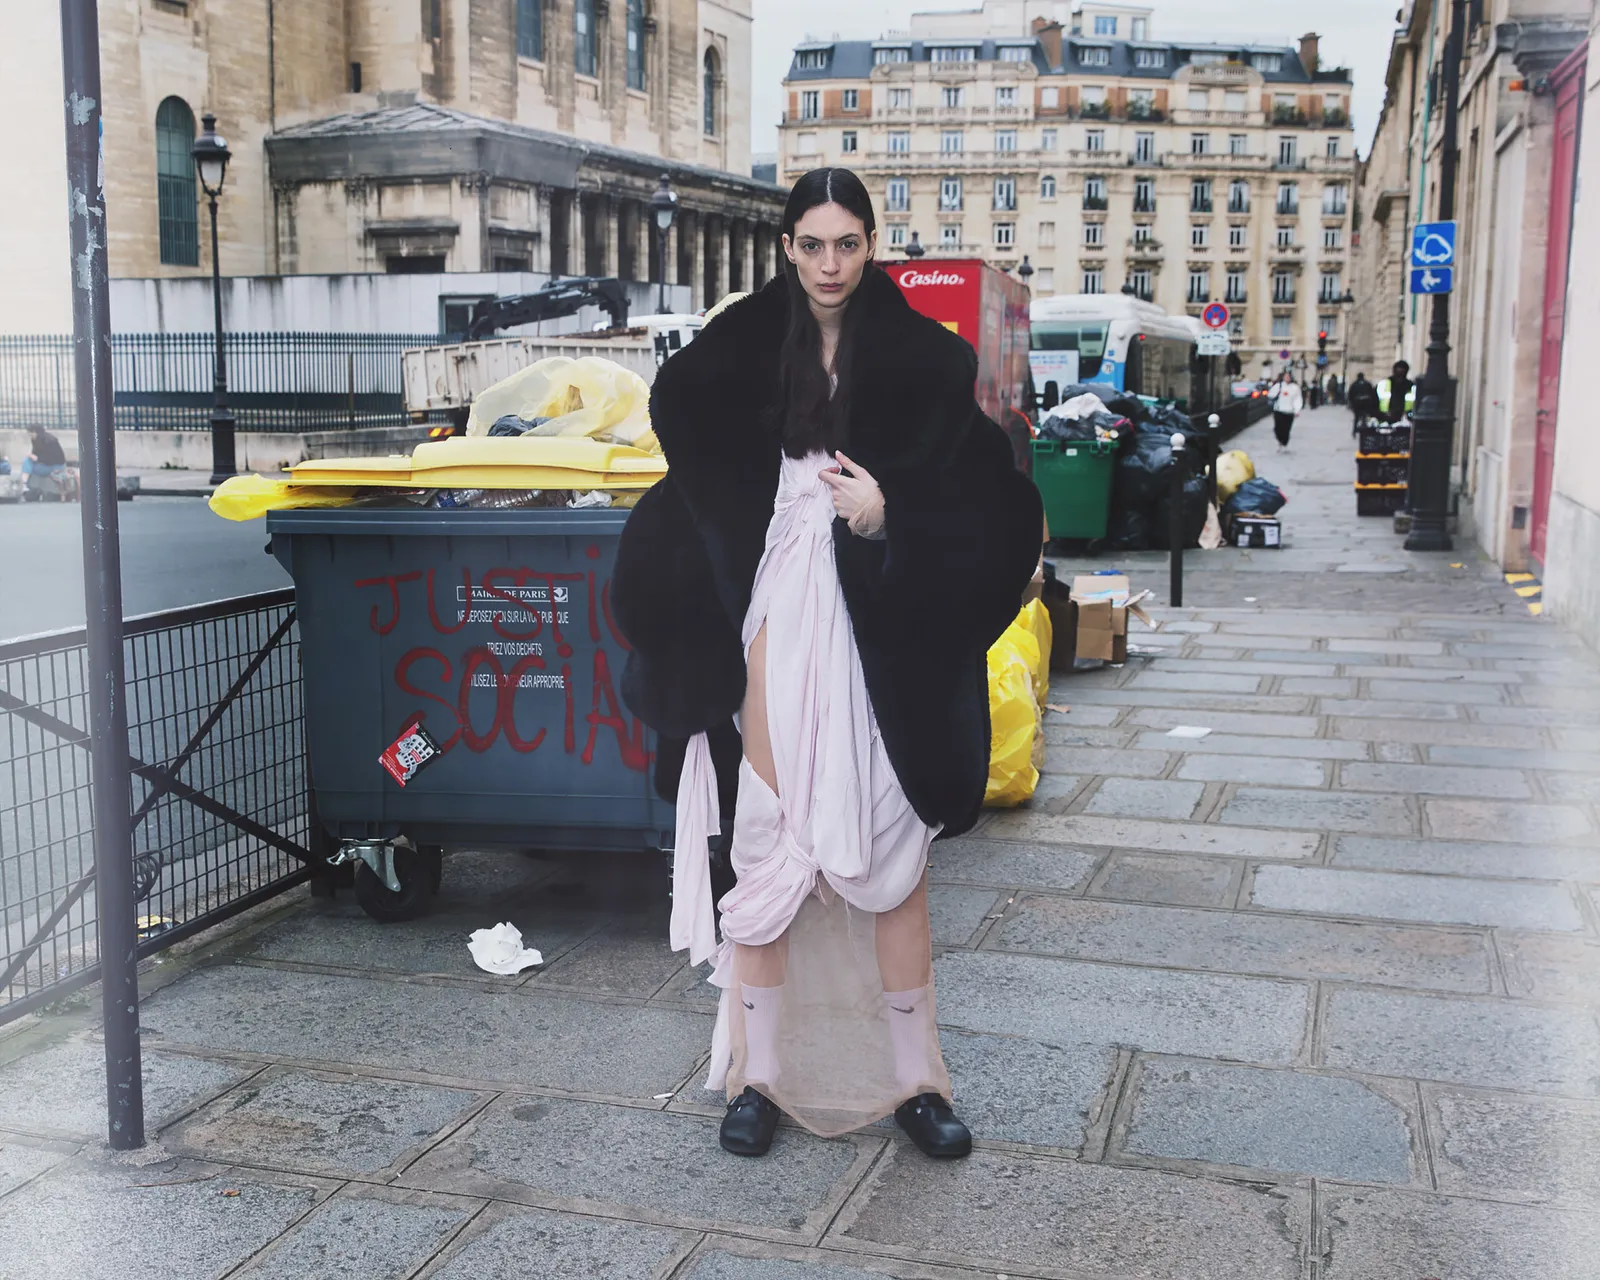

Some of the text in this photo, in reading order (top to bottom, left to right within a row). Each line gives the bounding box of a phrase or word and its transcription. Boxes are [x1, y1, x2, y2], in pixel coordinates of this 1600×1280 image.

[470, 590, 500, 599] MAIR
[519, 590, 547, 599] PARIS
[507, 611, 519, 623] SUR
[541, 611, 569, 624] PUBQUE
[503, 642, 516, 656] VOS
[516, 642, 543, 656] DECHETS
[469, 674, 490, 688] TILISEZ
